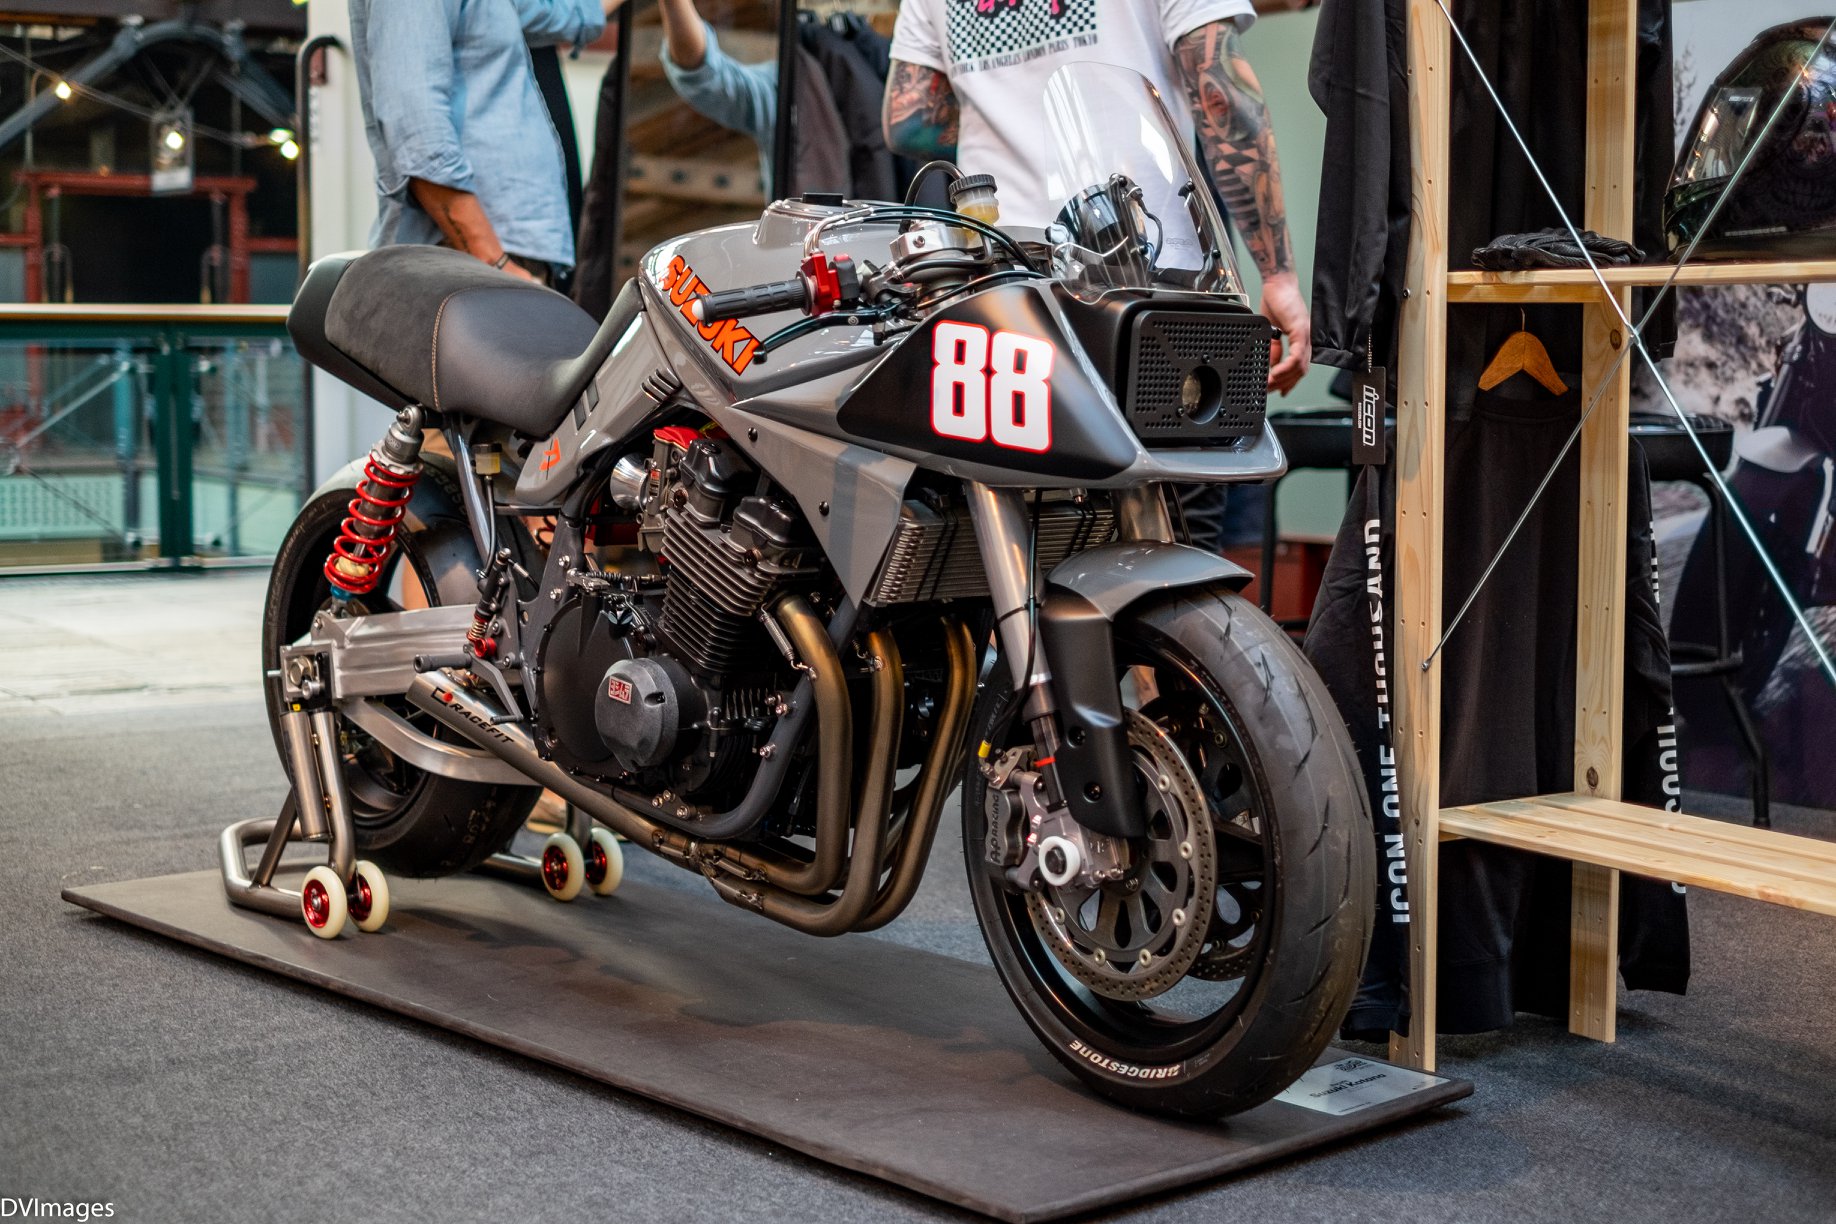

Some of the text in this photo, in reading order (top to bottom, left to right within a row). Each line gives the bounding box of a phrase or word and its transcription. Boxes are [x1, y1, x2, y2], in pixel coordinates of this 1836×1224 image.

[1048, 39, 1070, 55] PARIS
[660, 254, 760, 376] SUZUKI
[930, 319, 1057, 455] 88
[449, 702, 515, 744] RACEFIT
[1363, 519, 1411, 923] ICON ONE THOUSAND
[992, 794, 1001, 837] RACING
[1069, 1039, 1182, 1079] BRIDGESTONE
